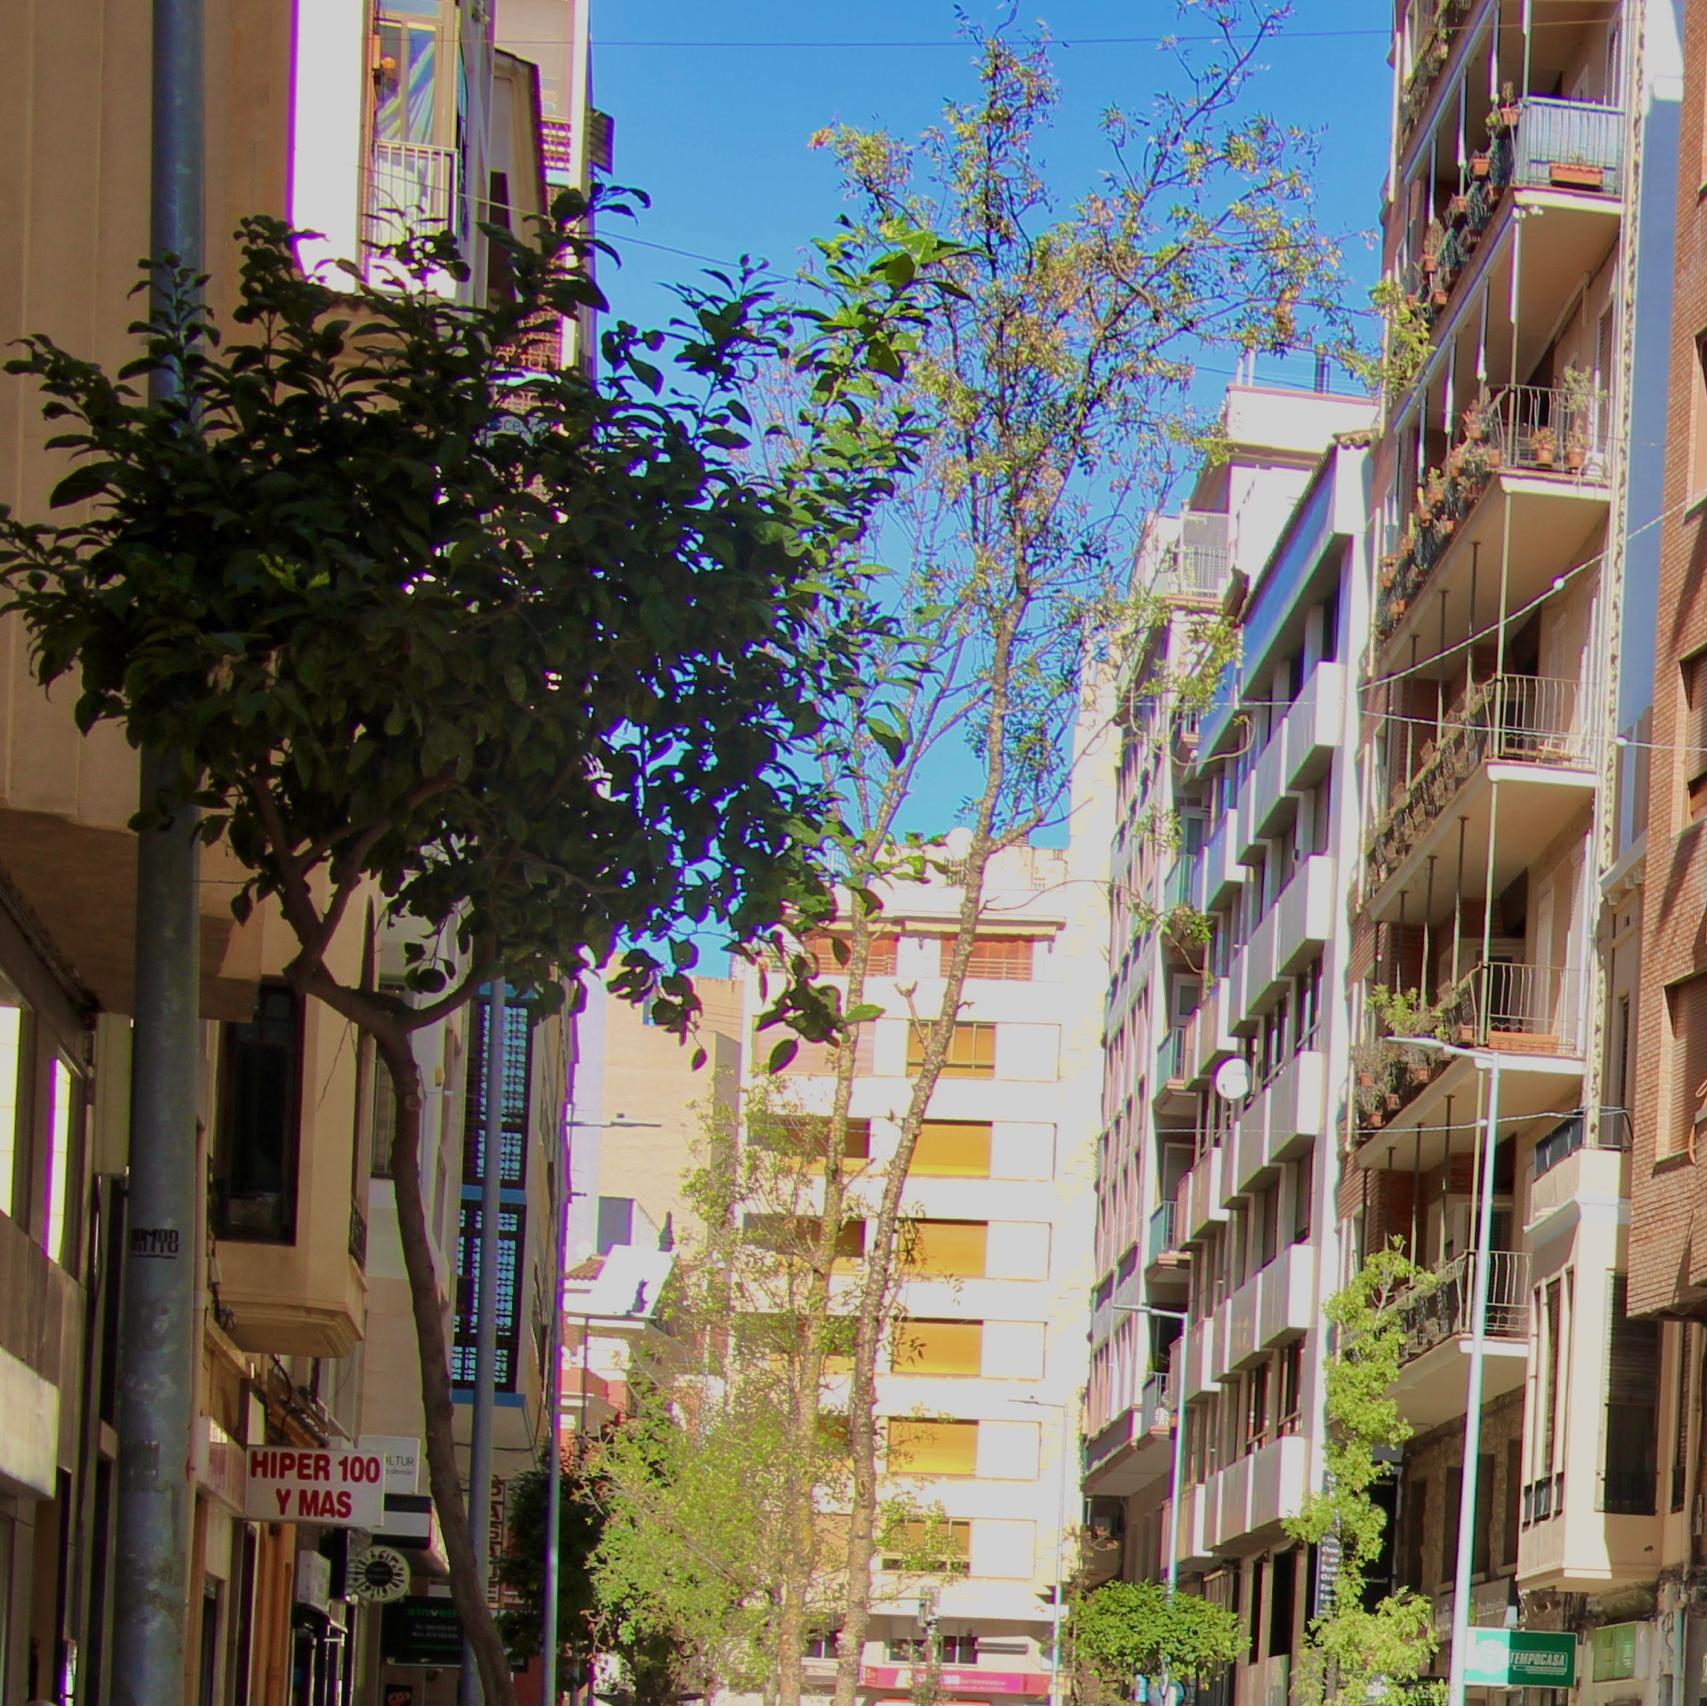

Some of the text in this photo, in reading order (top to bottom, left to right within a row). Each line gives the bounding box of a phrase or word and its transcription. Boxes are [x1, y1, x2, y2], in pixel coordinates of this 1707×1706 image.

[251, 1451, 380, 1483] HIPER 100
[275, 1488, 353, 1518] Y MAS
[1510, 1651, 1566, 1667] TEMPOCASA
